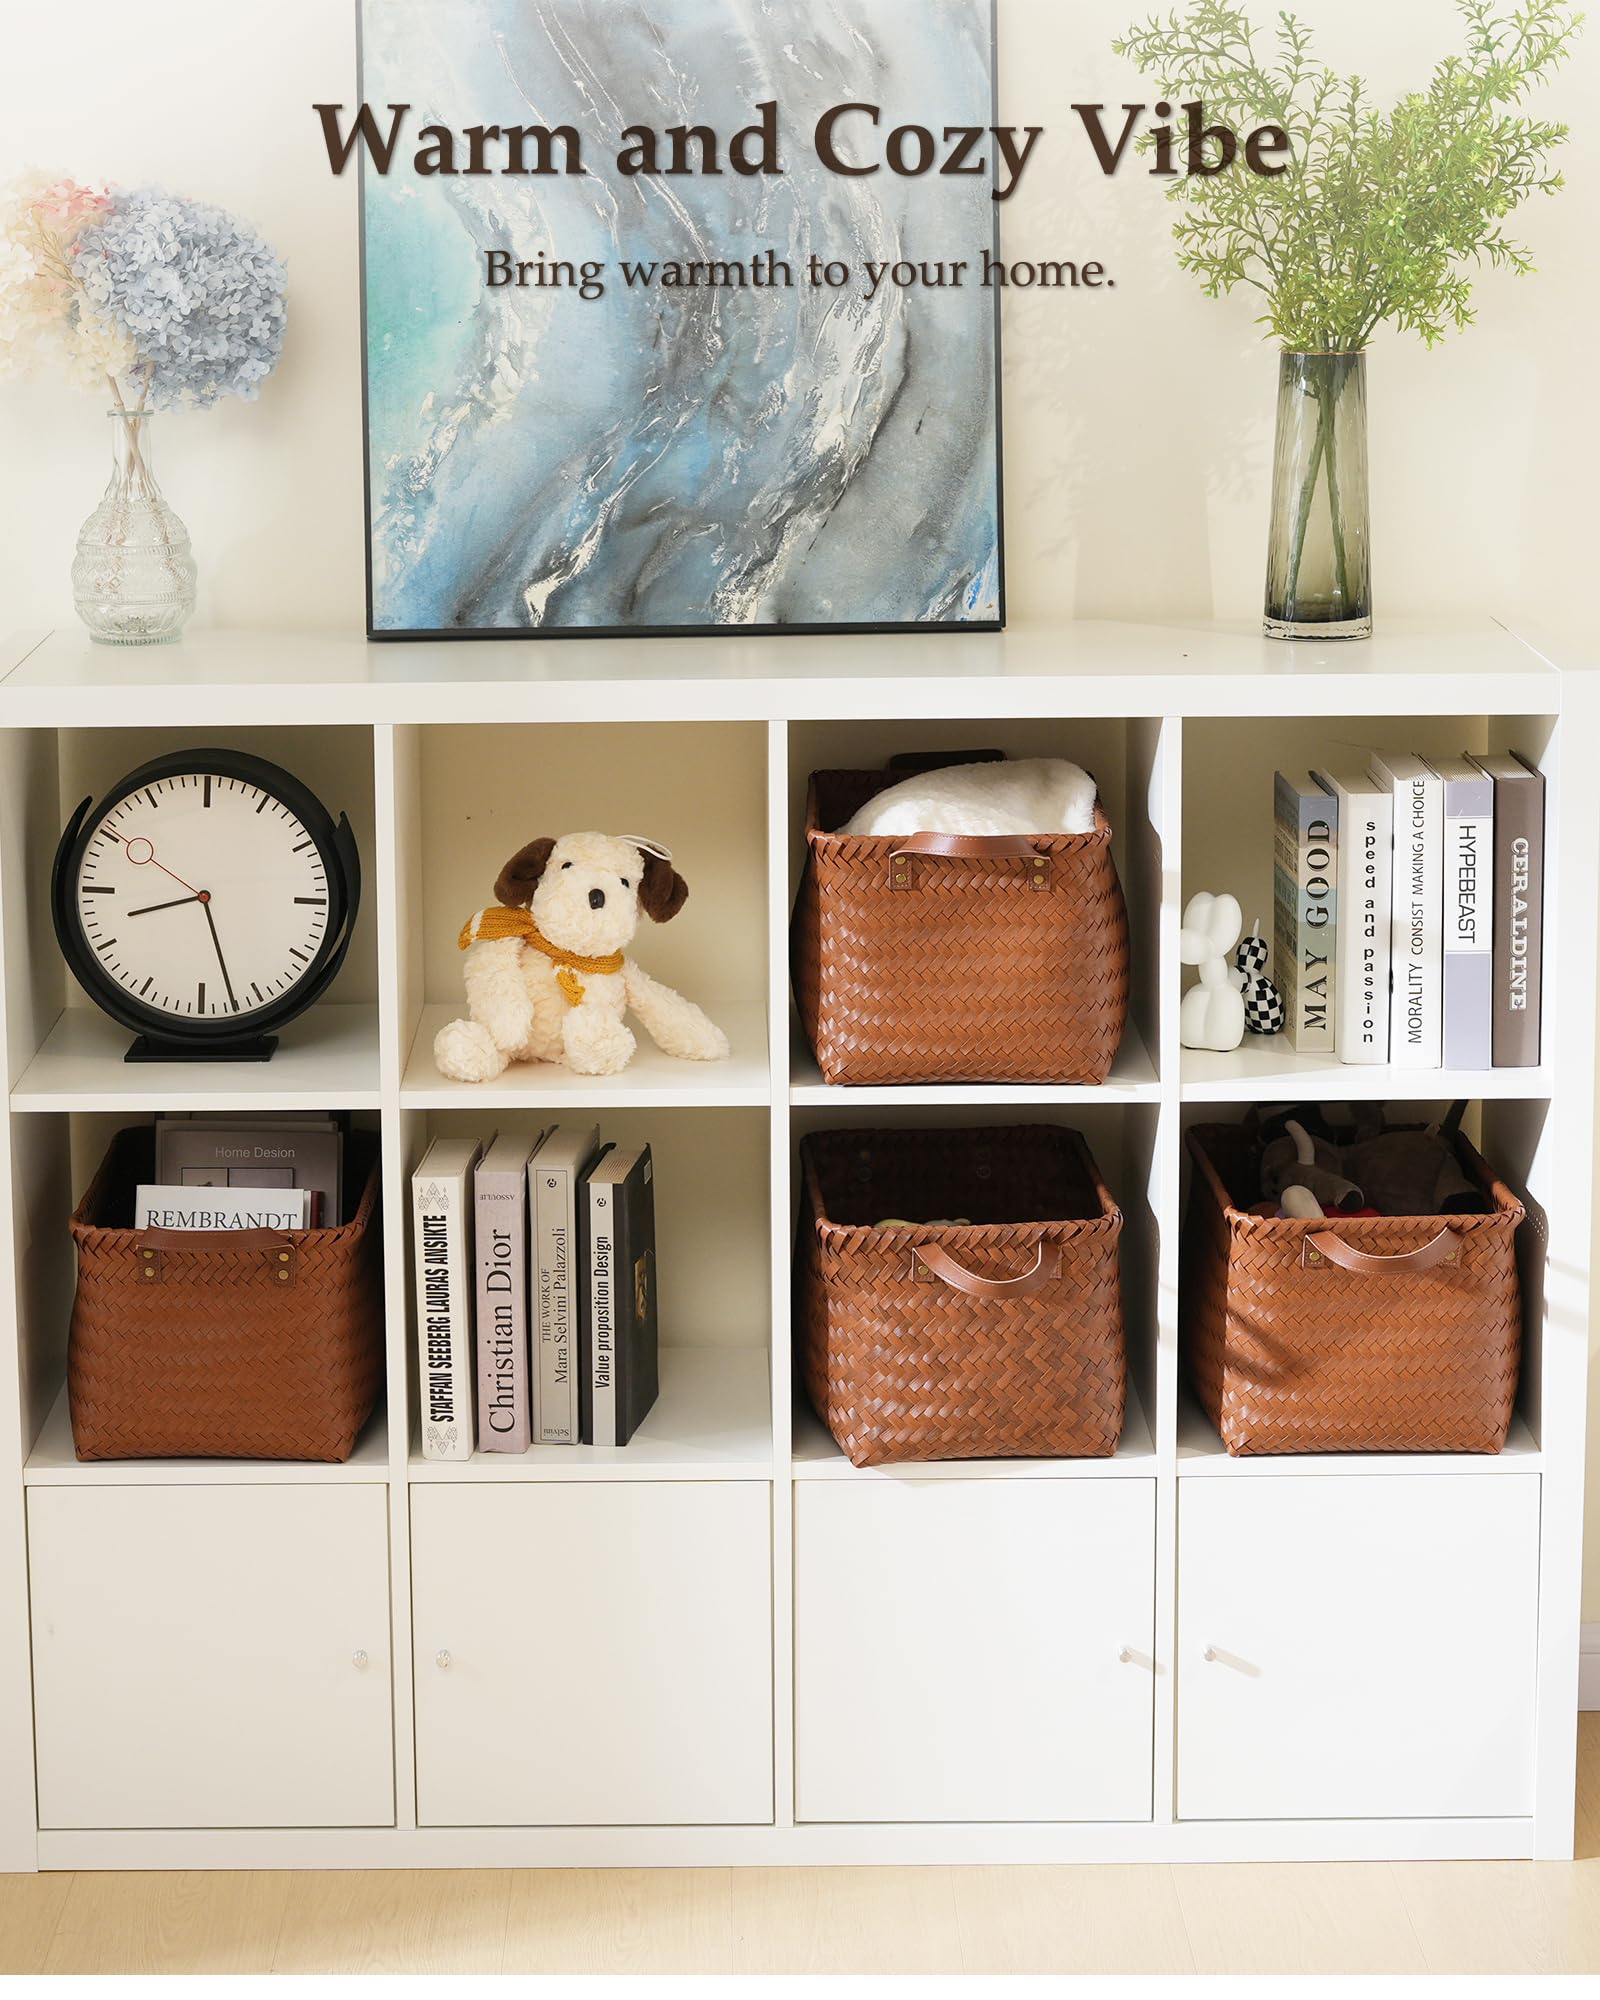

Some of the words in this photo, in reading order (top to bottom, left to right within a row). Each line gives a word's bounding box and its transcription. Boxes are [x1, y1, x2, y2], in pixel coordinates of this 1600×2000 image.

[1412, 780, 1425, 828] CHOICE
[1365, 821, 1376, 888] speed
[1412, 831, 1424, 840] A
[1306, 820, 1330, 929] GOOD
[1412, 843, 1424, 895] MAKING
[1458, 825, 1477, 944] HYPEBEAST
[1364, 899, 1375, 938] and
[1411, 902, 1424, 955] CONSIST
[1304, 949, 1328, 1031] MAY
[1363, 948, 1375, 1043] passion
[1408, 963, 1423, 1043] MORALITY
[215, 1146, 250, 1158] Home
[146, 1210, 298, 1230] REMBRANDT
[423, 1215, 448, 1265] ANSIKTE
[485, 1229, 512, 1294] Dior
[541, 1268, 550, 1283] OF
[552, 1228, 566, 1290] Palazzoli
[593, 1236, 612, 1276] Design
[425, 1268, 451, 1313] LAURAS
[541, 1286, 551, 1319] WORK
[542, 1321, 551, 1343] THE
[553, 1295, 568, 1344] Selvini
[594, 1281, 613, 1351] proposition
[426, 1317, 453, 1369] SEEBERG
[554, 1348, 568, 1384] Mara
[487, 1304, 515, 1433] Christian
[595, 1355, 610, 1389] Value
[429, 1372, 454, 1422] STAFFAN
